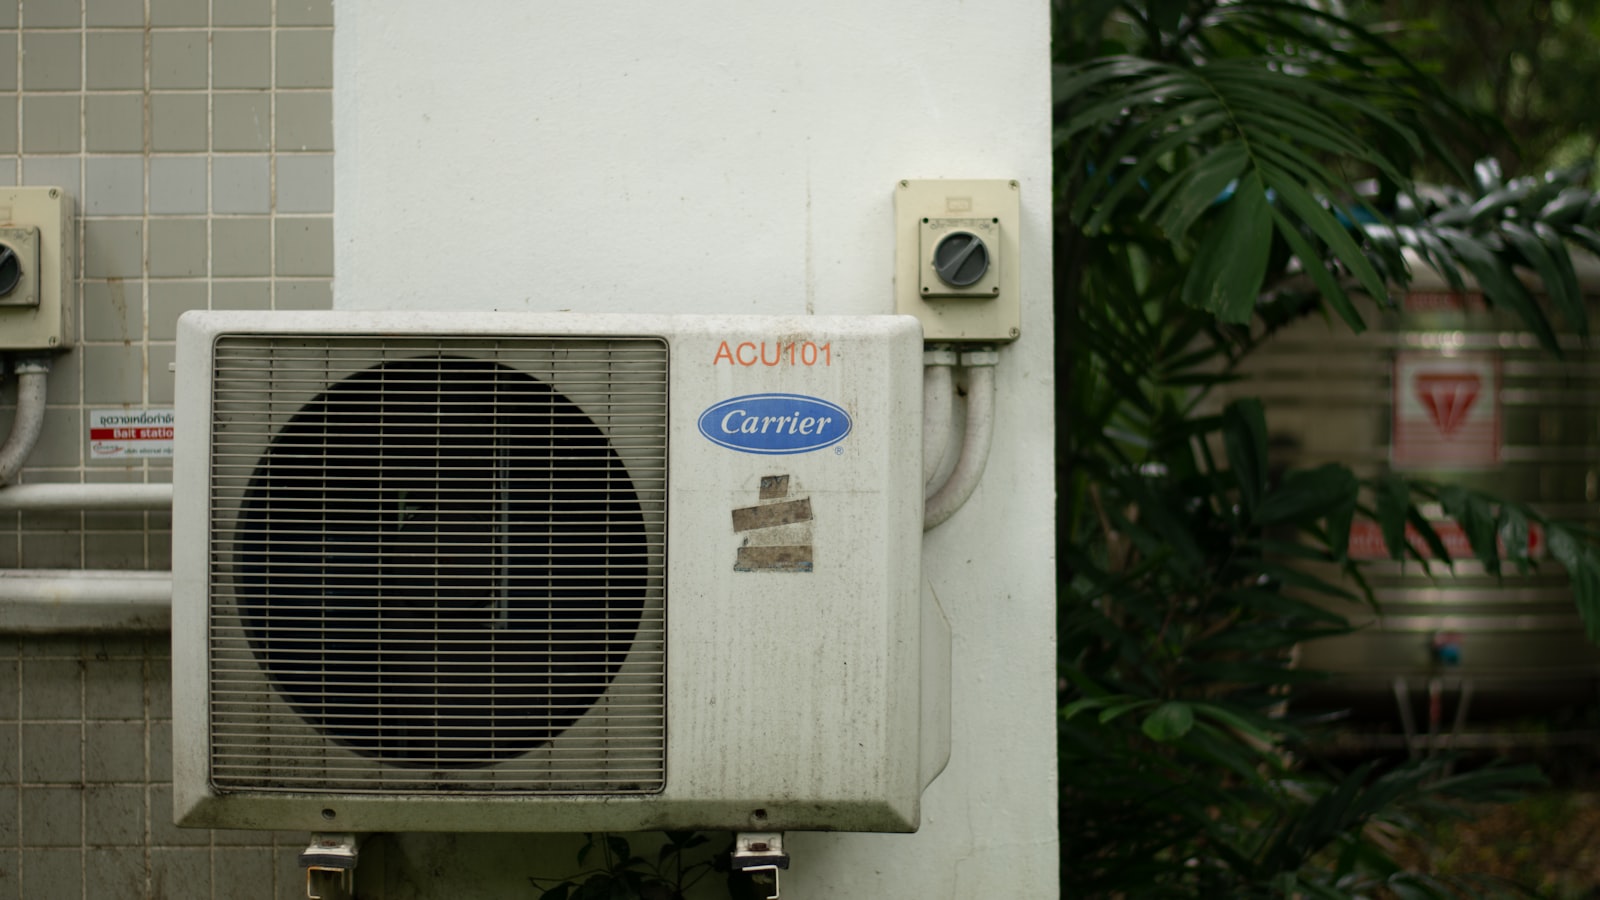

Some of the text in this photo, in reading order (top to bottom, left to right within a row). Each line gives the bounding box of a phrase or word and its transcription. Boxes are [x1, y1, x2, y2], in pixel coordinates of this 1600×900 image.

[713, 340, 832, 367] ACU101
[113, 428, 137, 439] Bait
[721, 409, 832, 436] Carrier
